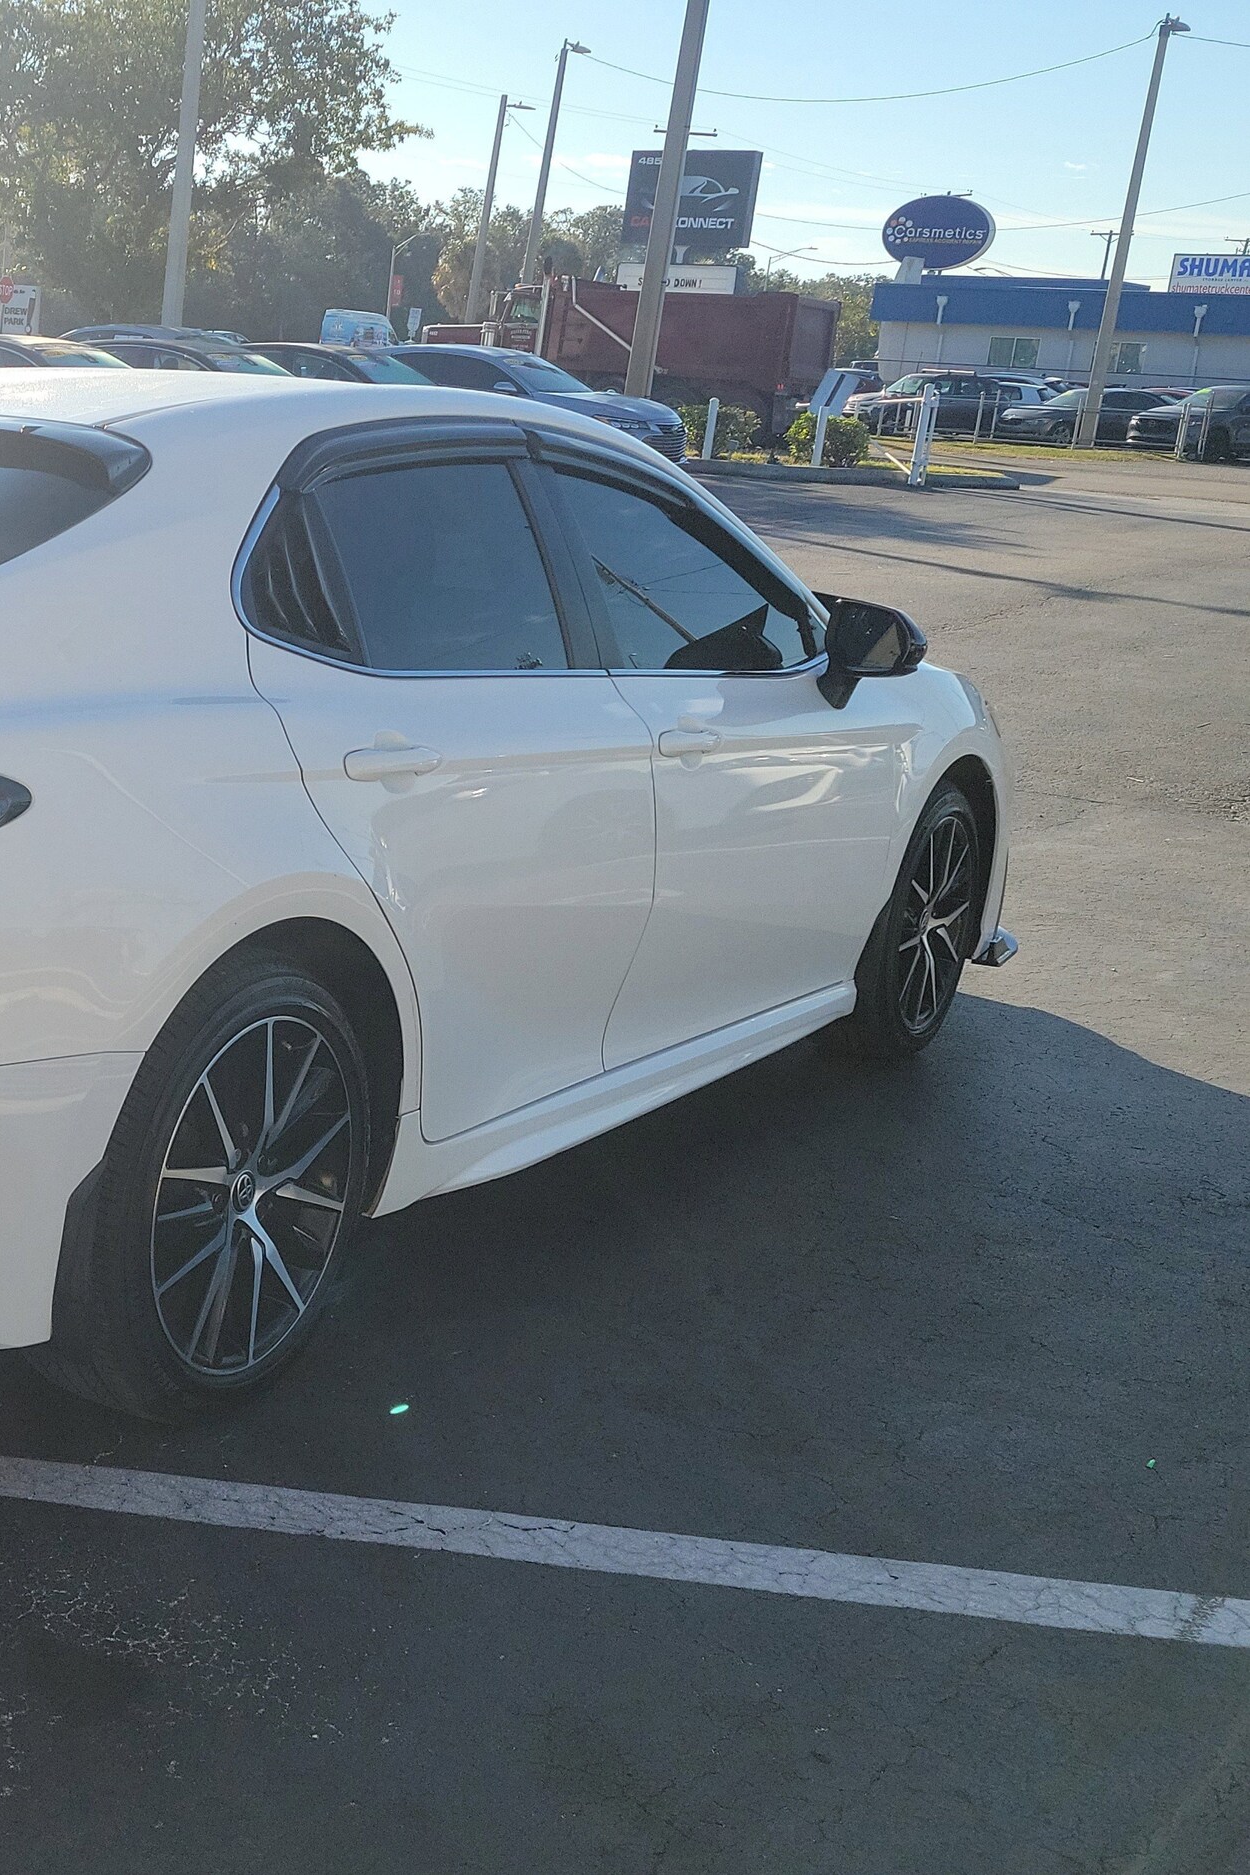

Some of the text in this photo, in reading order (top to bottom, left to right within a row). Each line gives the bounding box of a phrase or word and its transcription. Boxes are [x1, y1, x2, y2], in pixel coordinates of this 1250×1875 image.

[630, 216, 650, 227] CA
[894, 225, 985, 239] Carsmetics
[674, 278, 703, 288] DOWN!
[4, 307, 28, 315] DREW
[4, 317, 24, 326] PARK
